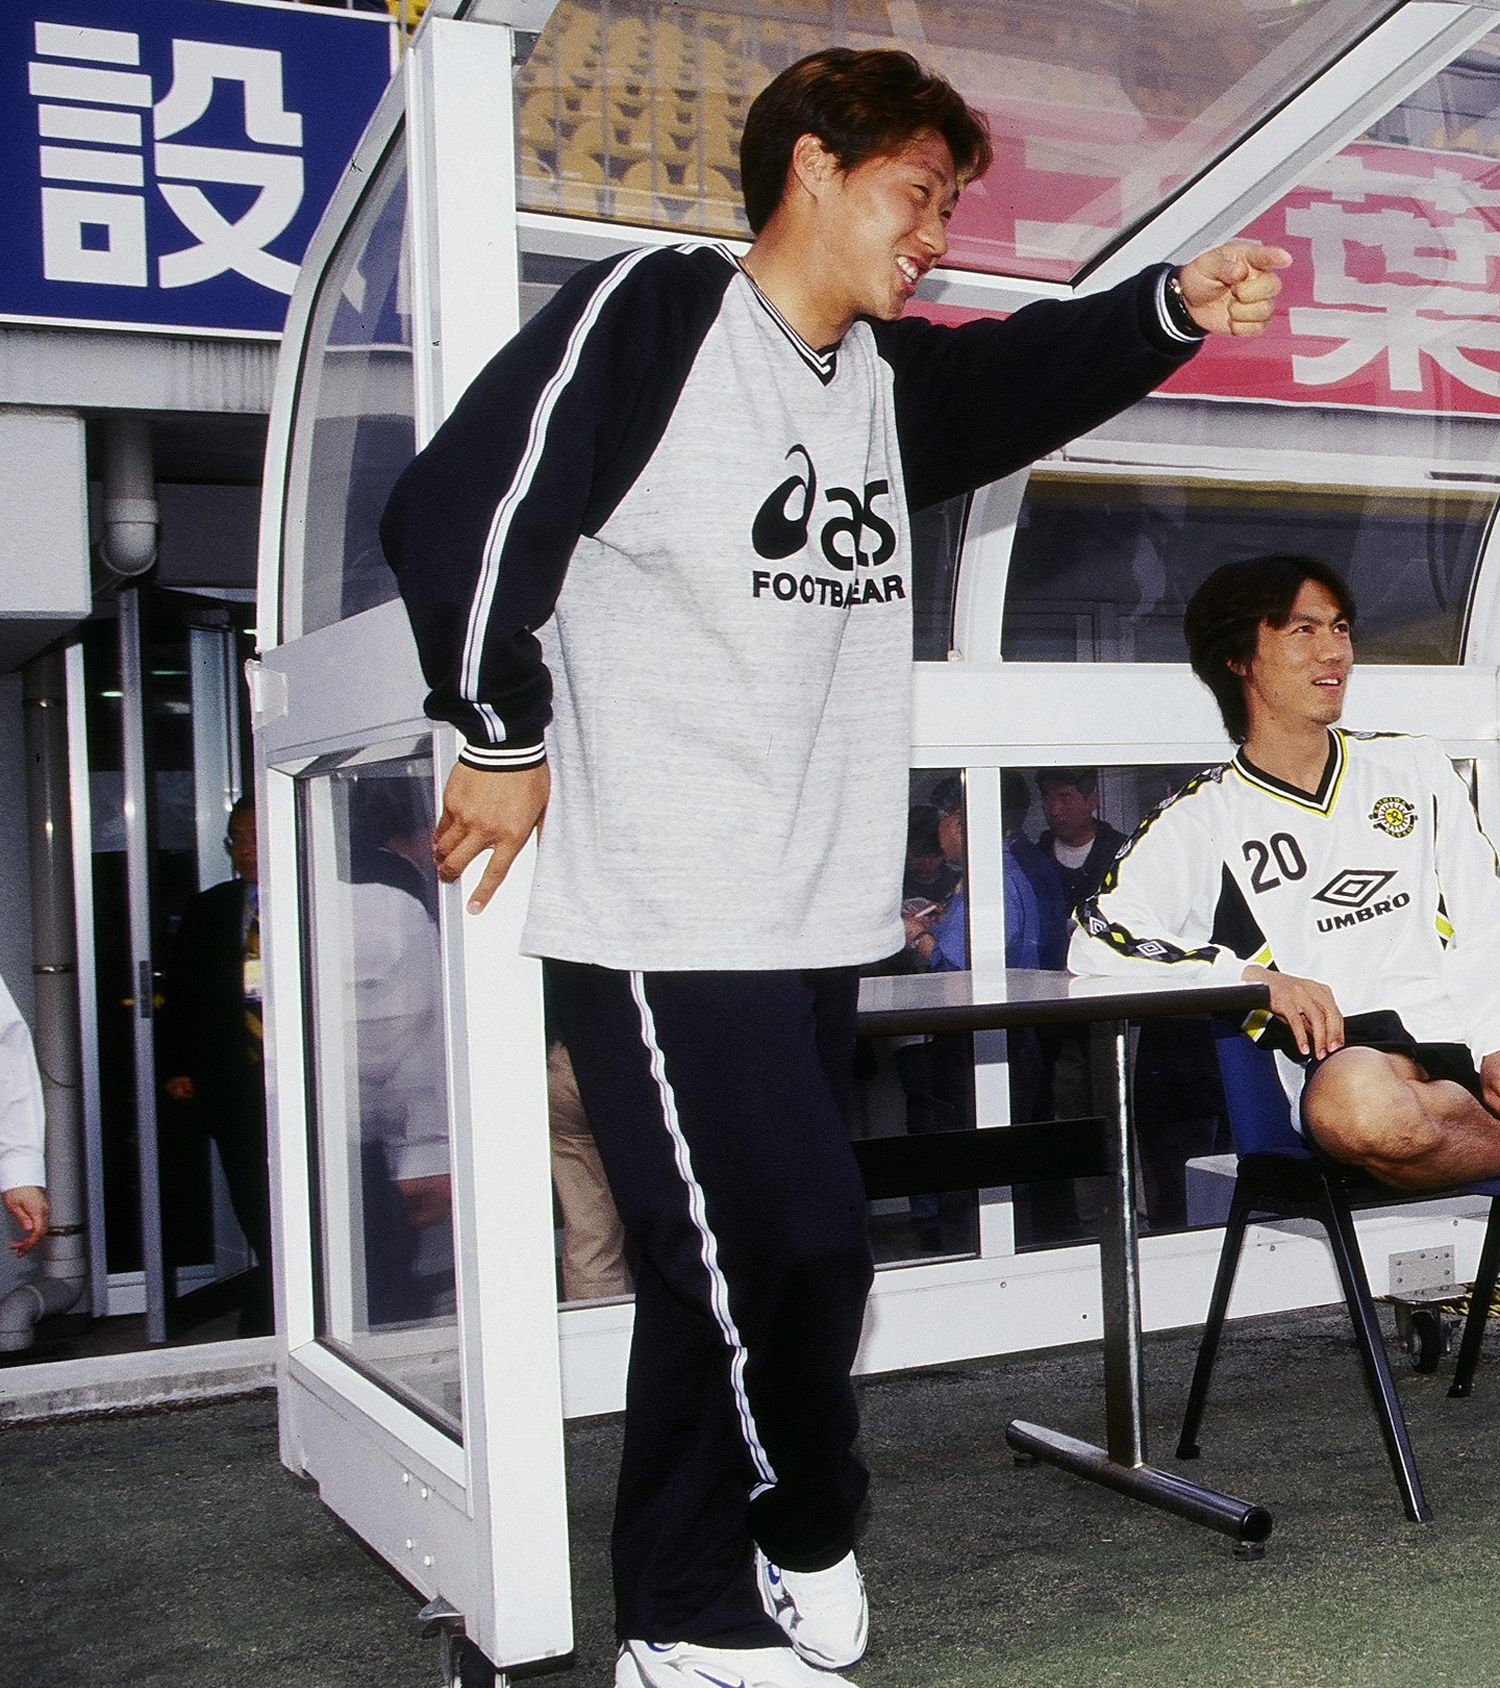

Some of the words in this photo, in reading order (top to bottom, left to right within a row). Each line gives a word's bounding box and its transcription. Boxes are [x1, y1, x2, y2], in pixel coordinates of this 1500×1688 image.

[28, 21, 366, 313] 設
[1242, 832, 1307, 894] 20
[1316, 892, 1411, 933] UMBRO
